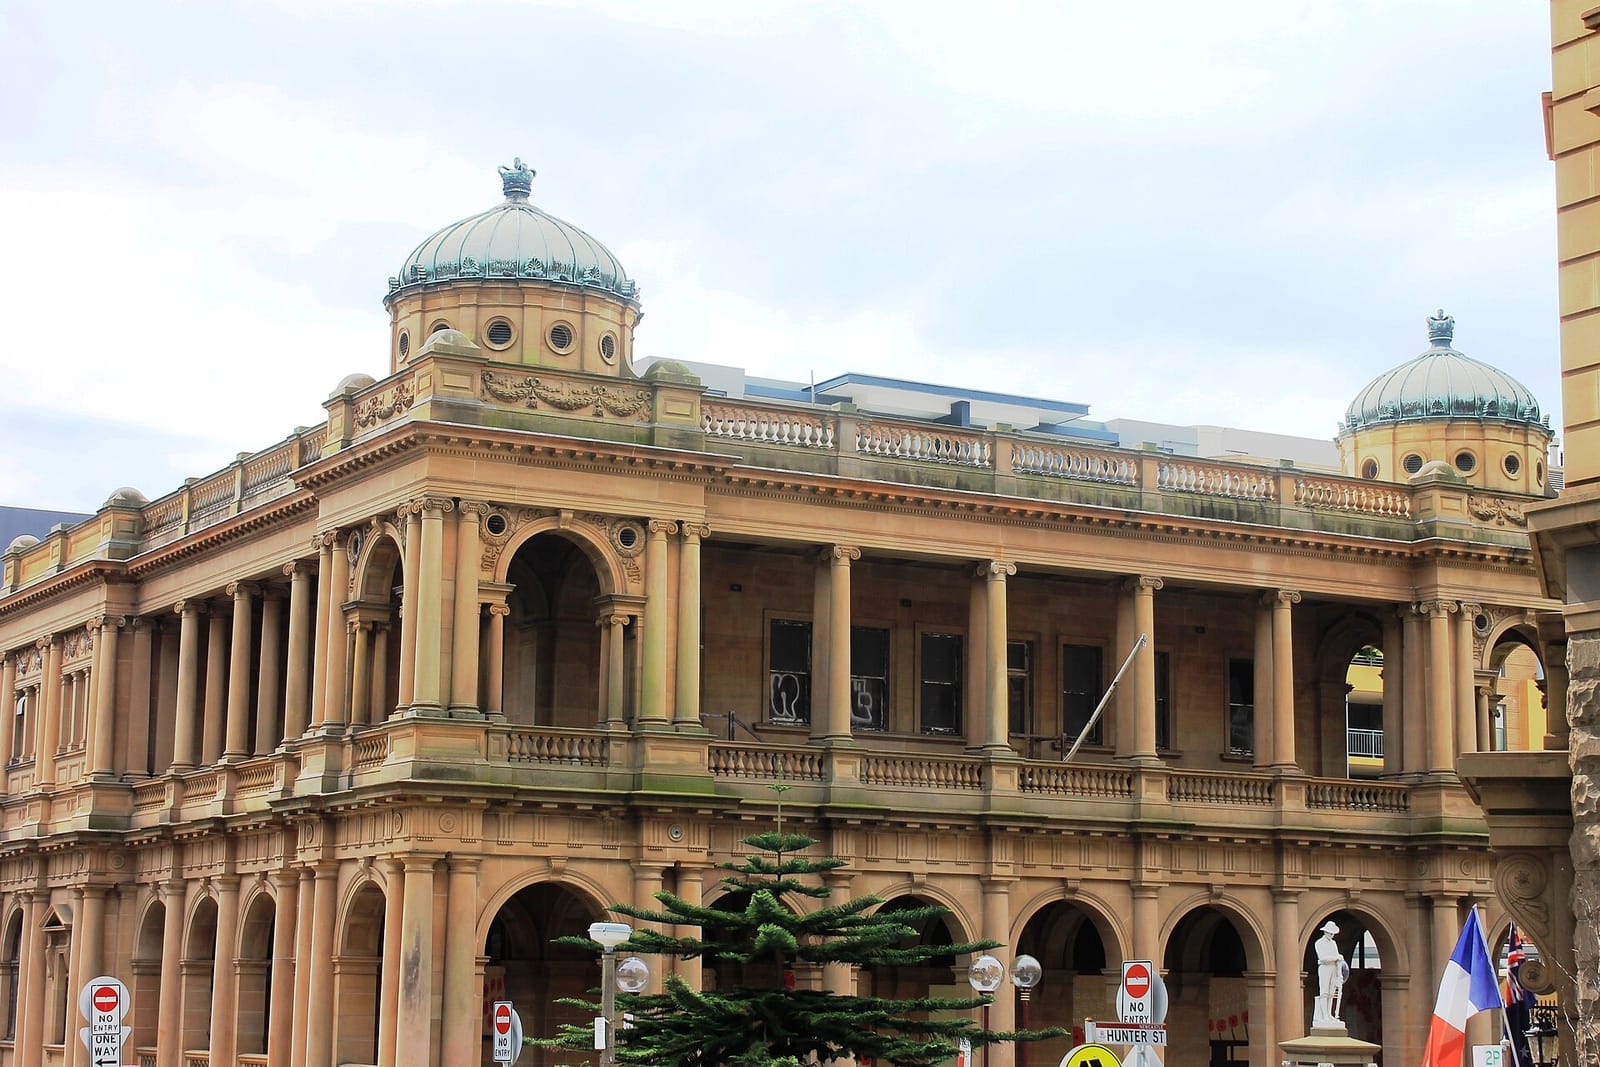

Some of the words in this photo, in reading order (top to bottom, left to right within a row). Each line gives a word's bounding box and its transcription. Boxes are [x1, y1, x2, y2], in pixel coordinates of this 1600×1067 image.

[1130, 1002, 1144, 1012] NO
[1124, 1015, 1149, 1023] ENTRY
[95, 1035, 116, 1043] ONE
[1107, 1030, 1147, 1043] HUNTER
[1153, 1031, 1164, 1043] ST
[498, 1038, 508, 1047] NO
[94, 1046, 118, 1056] WAY
[495, 1049, 510, 1057] ENTRY
[1485, 1050, 1500, 1066] 2P
